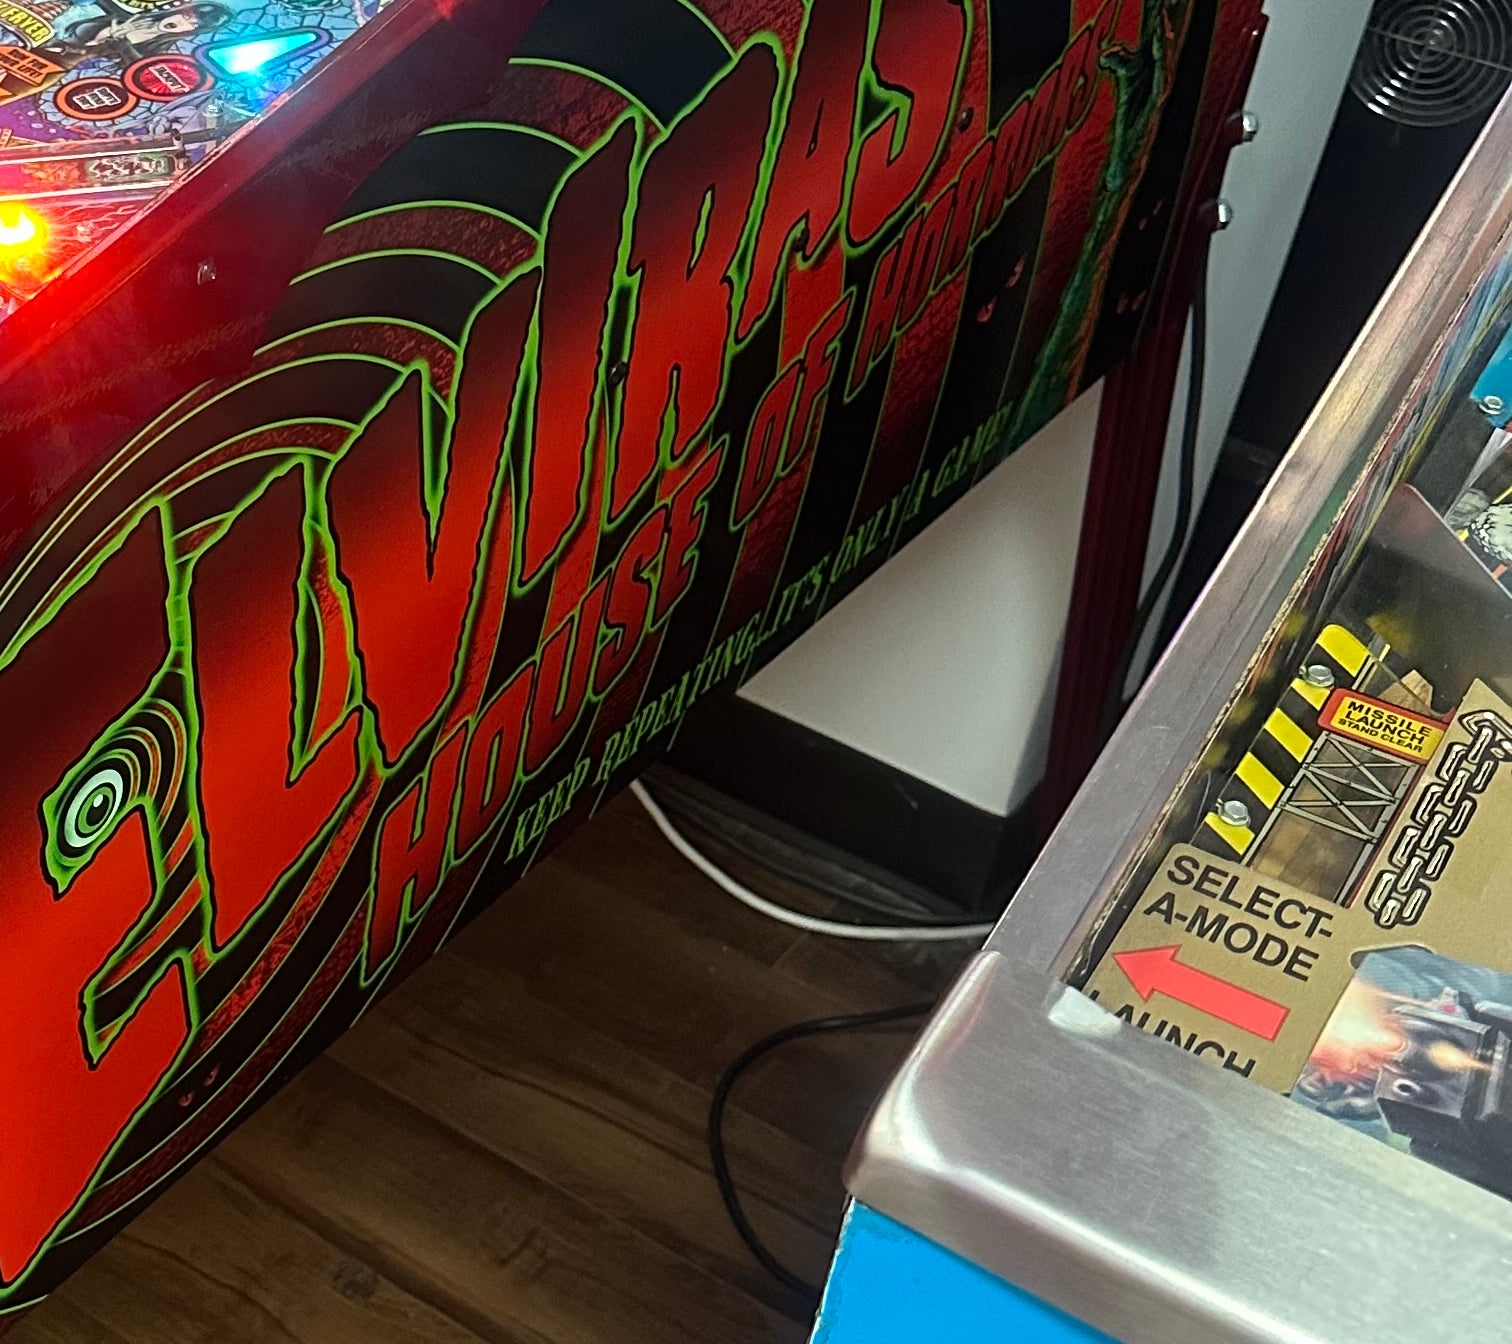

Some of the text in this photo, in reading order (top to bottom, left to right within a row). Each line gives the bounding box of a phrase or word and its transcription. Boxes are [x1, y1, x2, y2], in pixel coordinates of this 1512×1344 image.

[3, 6, 54, 44] FRYER
[360, 435, 731, 988] HOUSE
[729, 286, 856, 532] OF
[505, 758, 591, 864] KEEP
[829, 512, 904, 586] ONLY
[902, 482, 927, 522] A
[1337, 718, 1424, 753] STAND CLEAR
[1345, 710, 1425, 746] LAUNCH
[1346, 700, 1433, 737] MISSILE
[1167, 855, 1333, 940] SELECT-
[1144, 891, 1319, 982] A-MODE
